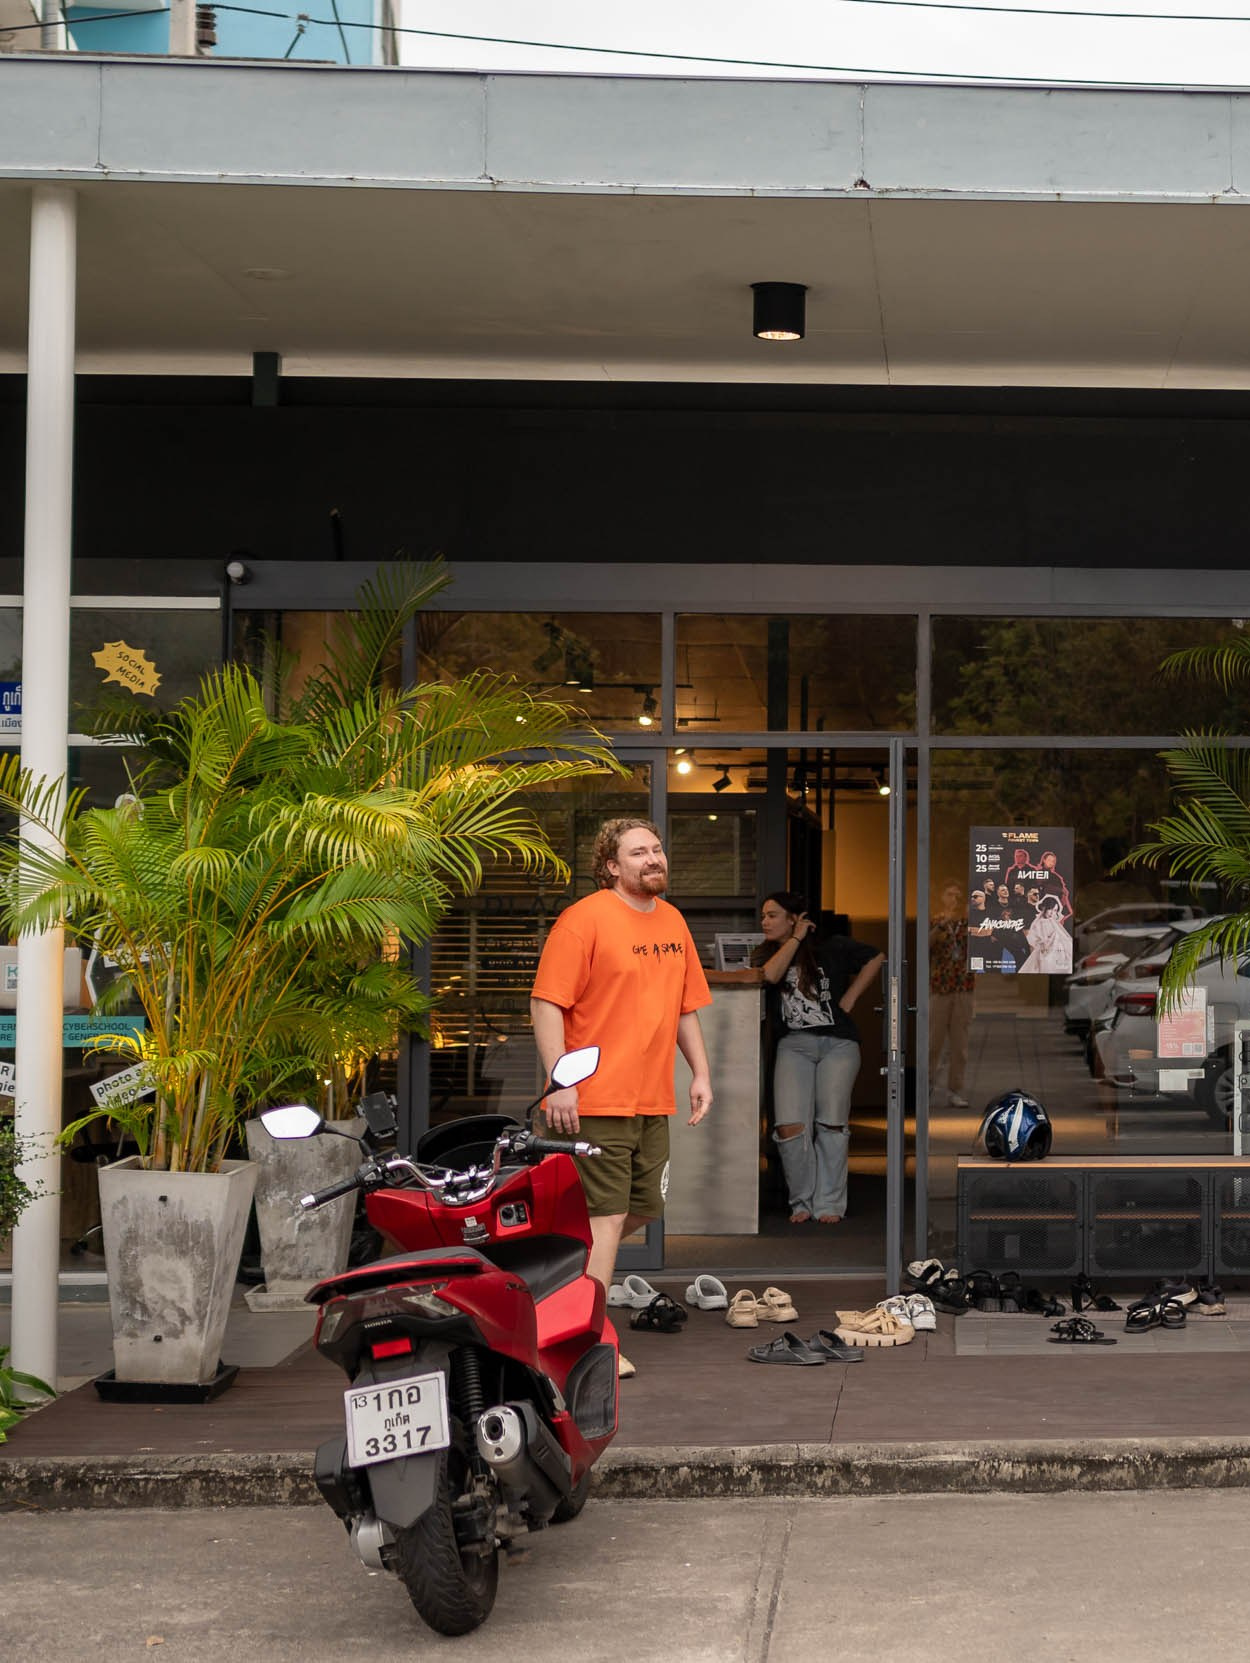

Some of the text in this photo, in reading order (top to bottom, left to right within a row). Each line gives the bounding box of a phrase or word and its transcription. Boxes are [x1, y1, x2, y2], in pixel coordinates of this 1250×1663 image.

[116, 651, 145, 675] SOCIAL
[115, 666, 145, 688] MEDIA
[975, 844, 988, 852] 25
[975, 854, 988, 863] 10
[975, 864, 988, 872] 25
[96, 1073, 132, 1097] photo
[384, 1412, 411, 1432] ภูเก็ต
[365, 1425, 432, 1457] 3317
